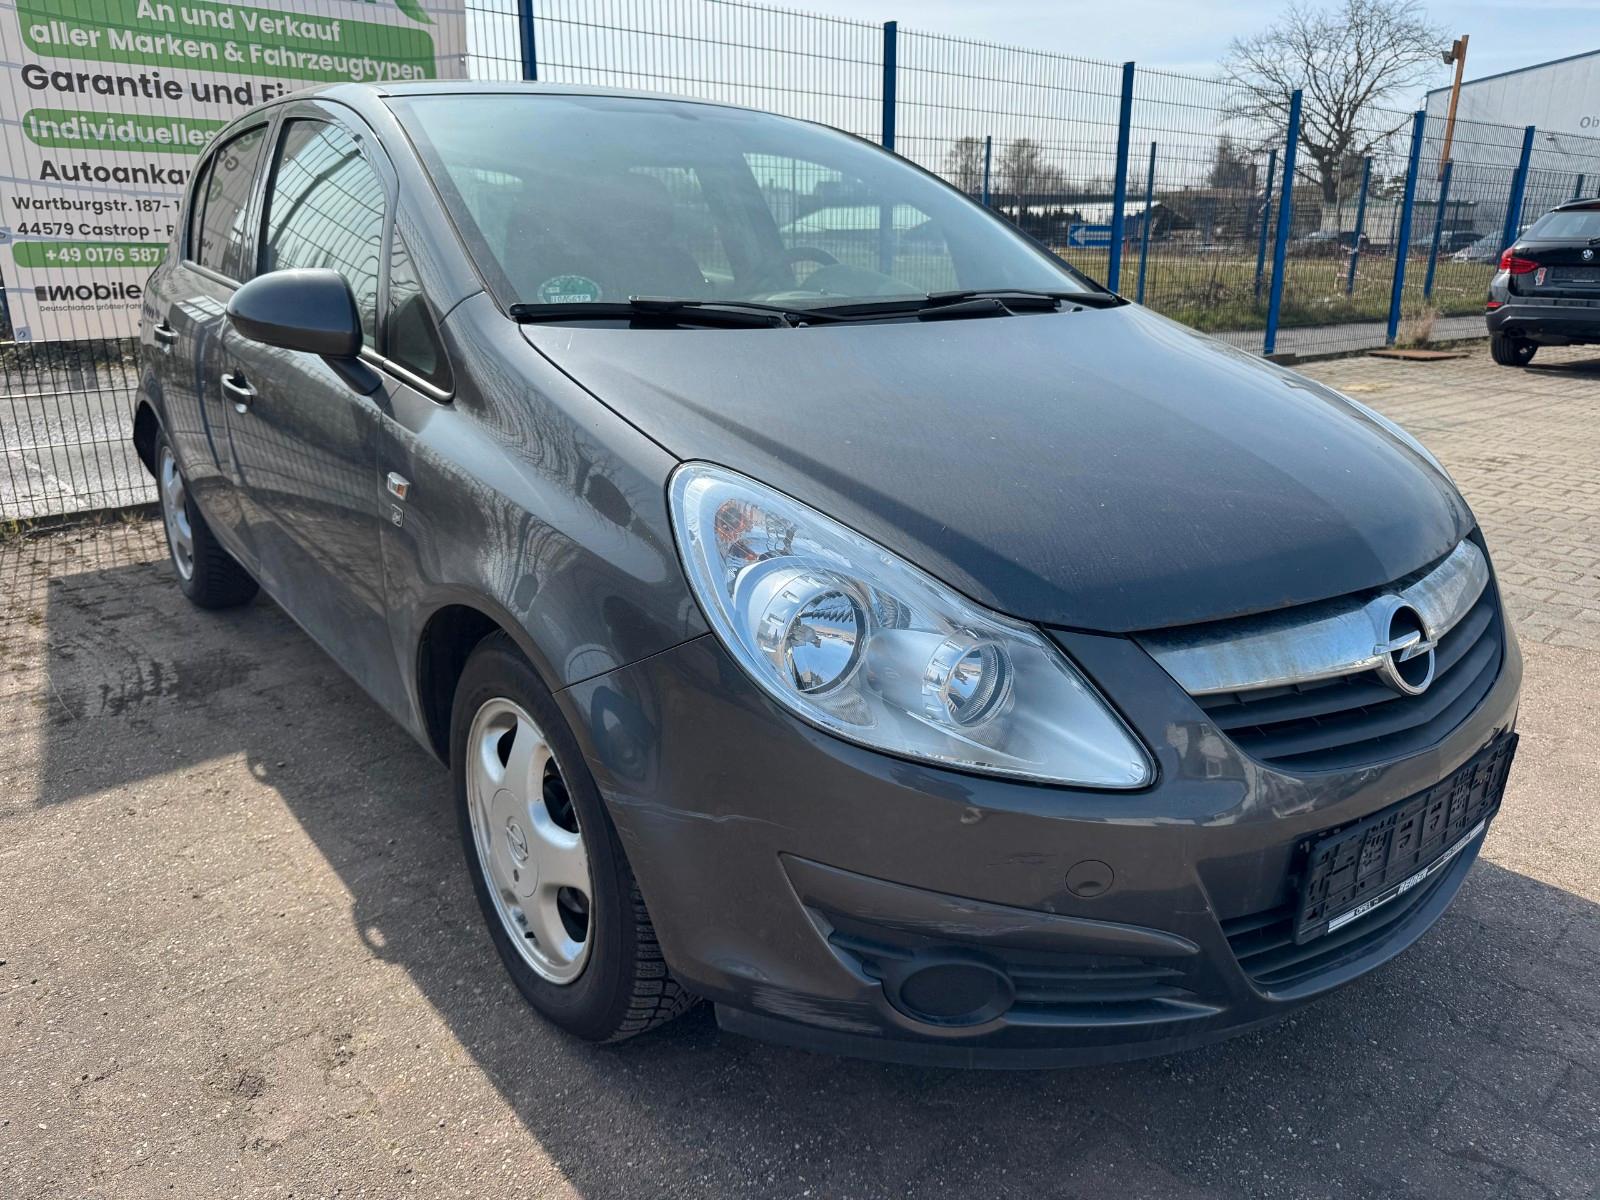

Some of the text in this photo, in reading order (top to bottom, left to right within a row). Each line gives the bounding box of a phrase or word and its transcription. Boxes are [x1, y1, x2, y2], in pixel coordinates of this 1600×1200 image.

[137, 0, 341, 42] An und Verkauf
[29, 21, 425, 81] aller Marken & Fahrzeugtypen
[21, 63, 293, 106] Garantie und Ei
[39, 160, 191, 185] Autoanka
[11, 196, 132, 215] Wartburgstr.
[17, 221, 74, 236] 44579
[78, 222, 150, 240] Castrop
[45, 247, 82, 262] +49
[85, 247, 125, 262] 0176
[129, 247, 160, 262] 587
[40, 303, 95, 312] Deutschlands
